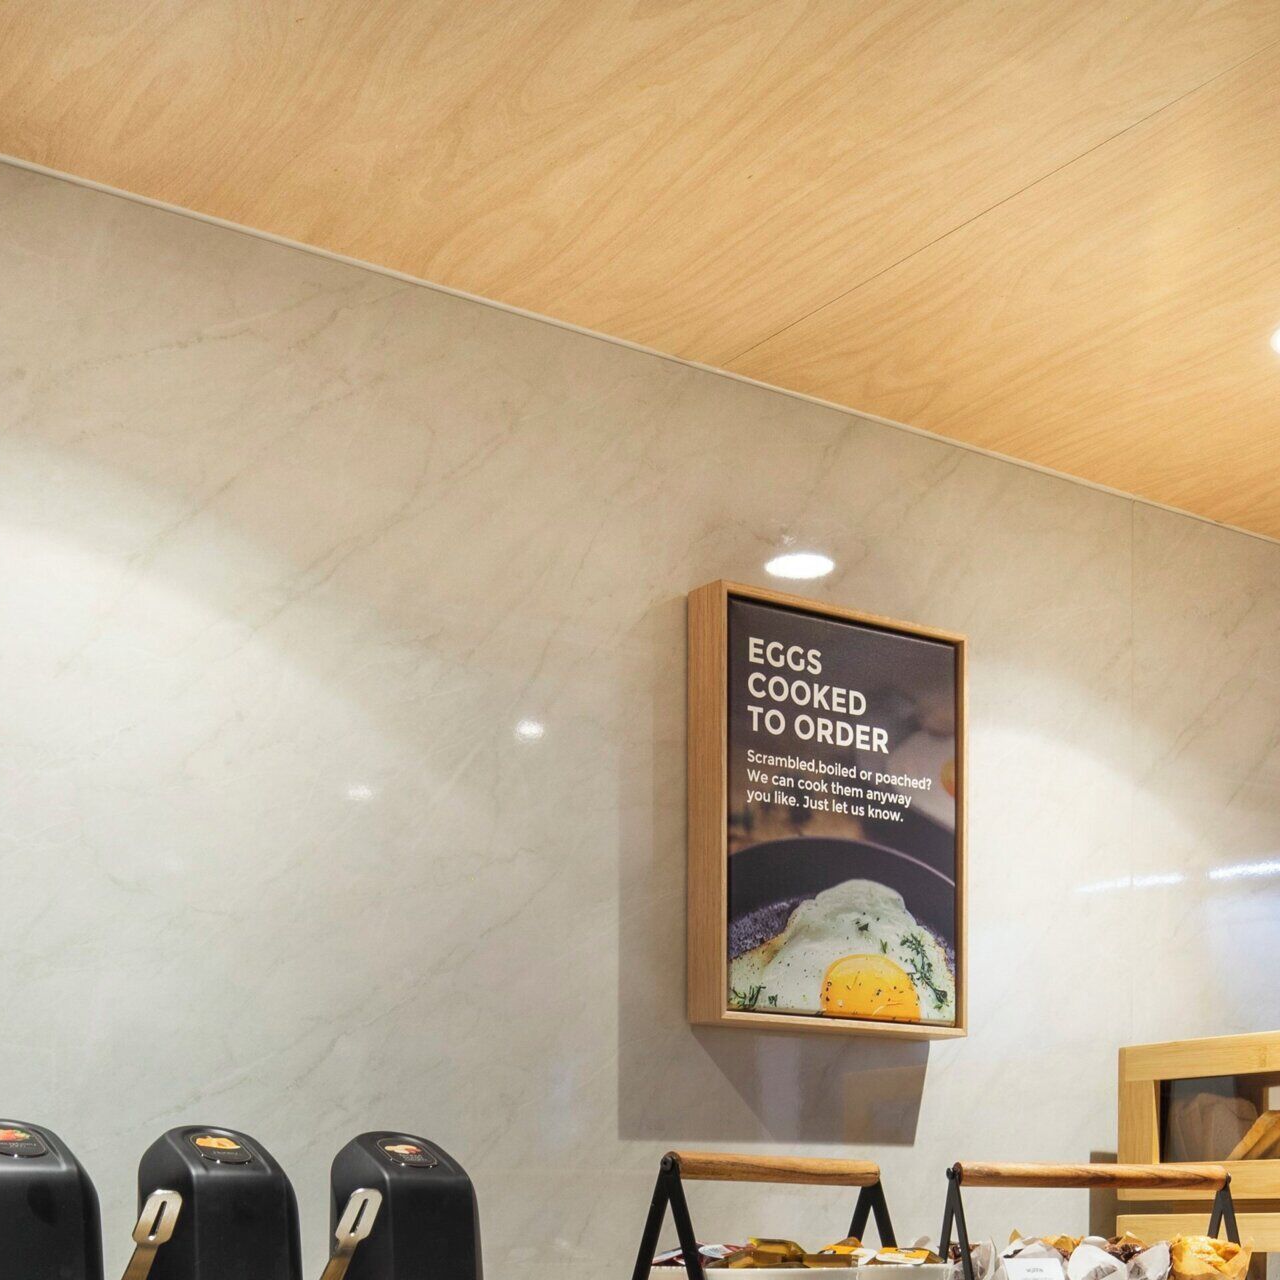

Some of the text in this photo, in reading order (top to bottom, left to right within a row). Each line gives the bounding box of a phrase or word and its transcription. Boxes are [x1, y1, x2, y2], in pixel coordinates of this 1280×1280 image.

[748, 636, 822, 675] EGGS
[747, 671, 867, 716] COOKED
[747, 705, 889, 754] TO ORDER
[746, 768, 912, 808] We can cook them anyway
[747, 749, 932, 790] Scrambled,boiled or poached?
[746, 789, 904, 822] you like. Just let us know.
